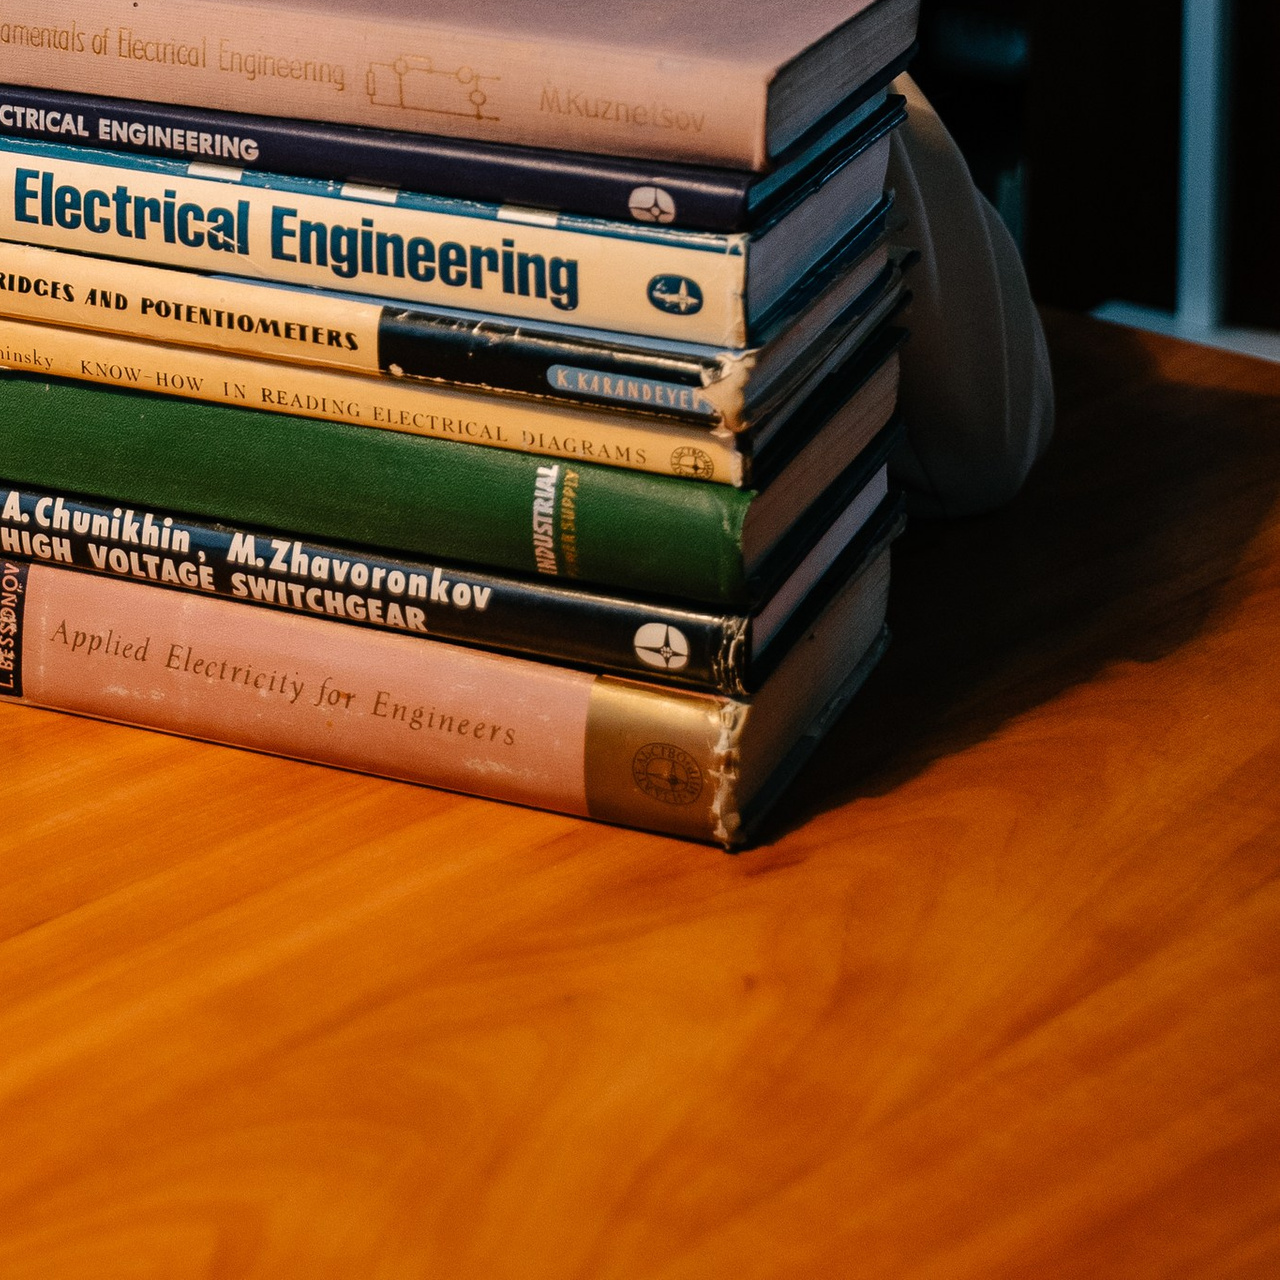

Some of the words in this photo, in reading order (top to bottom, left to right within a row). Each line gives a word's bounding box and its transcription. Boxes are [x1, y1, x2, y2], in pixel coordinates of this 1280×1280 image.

[91, 27, 110, 57] of
[118, 29, 207, 69] Electrical
[219, 36, 346, 92] Engineering
[98, 117, 260, 162] ENGINEERING
[14, 166, 250, 256] Electrical
[271, 204, 579, 311] Engineering
[84, 286, 128, 312] AND
[140, 297, 359, 352] POTENTIOMETERS
[80, 359, 205, 392] KNOW-HOW
[223, 381, 247, 400] IN
[261, 387, 361, 418] READING
[373, 406, 509, 443] ELECTRICAL
[521, 428, 648, 466] DIAGRAMS
[532, 464, 560, 576] INDUSTRIAL
[561, 468, 580, 531] SUPPLY
[0, 526, 73, 564] HIGH
[88, 543, 216, 592] VOLTAGE
[232, 572, 429, 633] SWITCHGEAR
[50, 618, 149, 664] Applied
[165, 644, 305, 704] Electricity
[314, 676, 357, 712] for
[371, 691, 516, 747] Engineers
